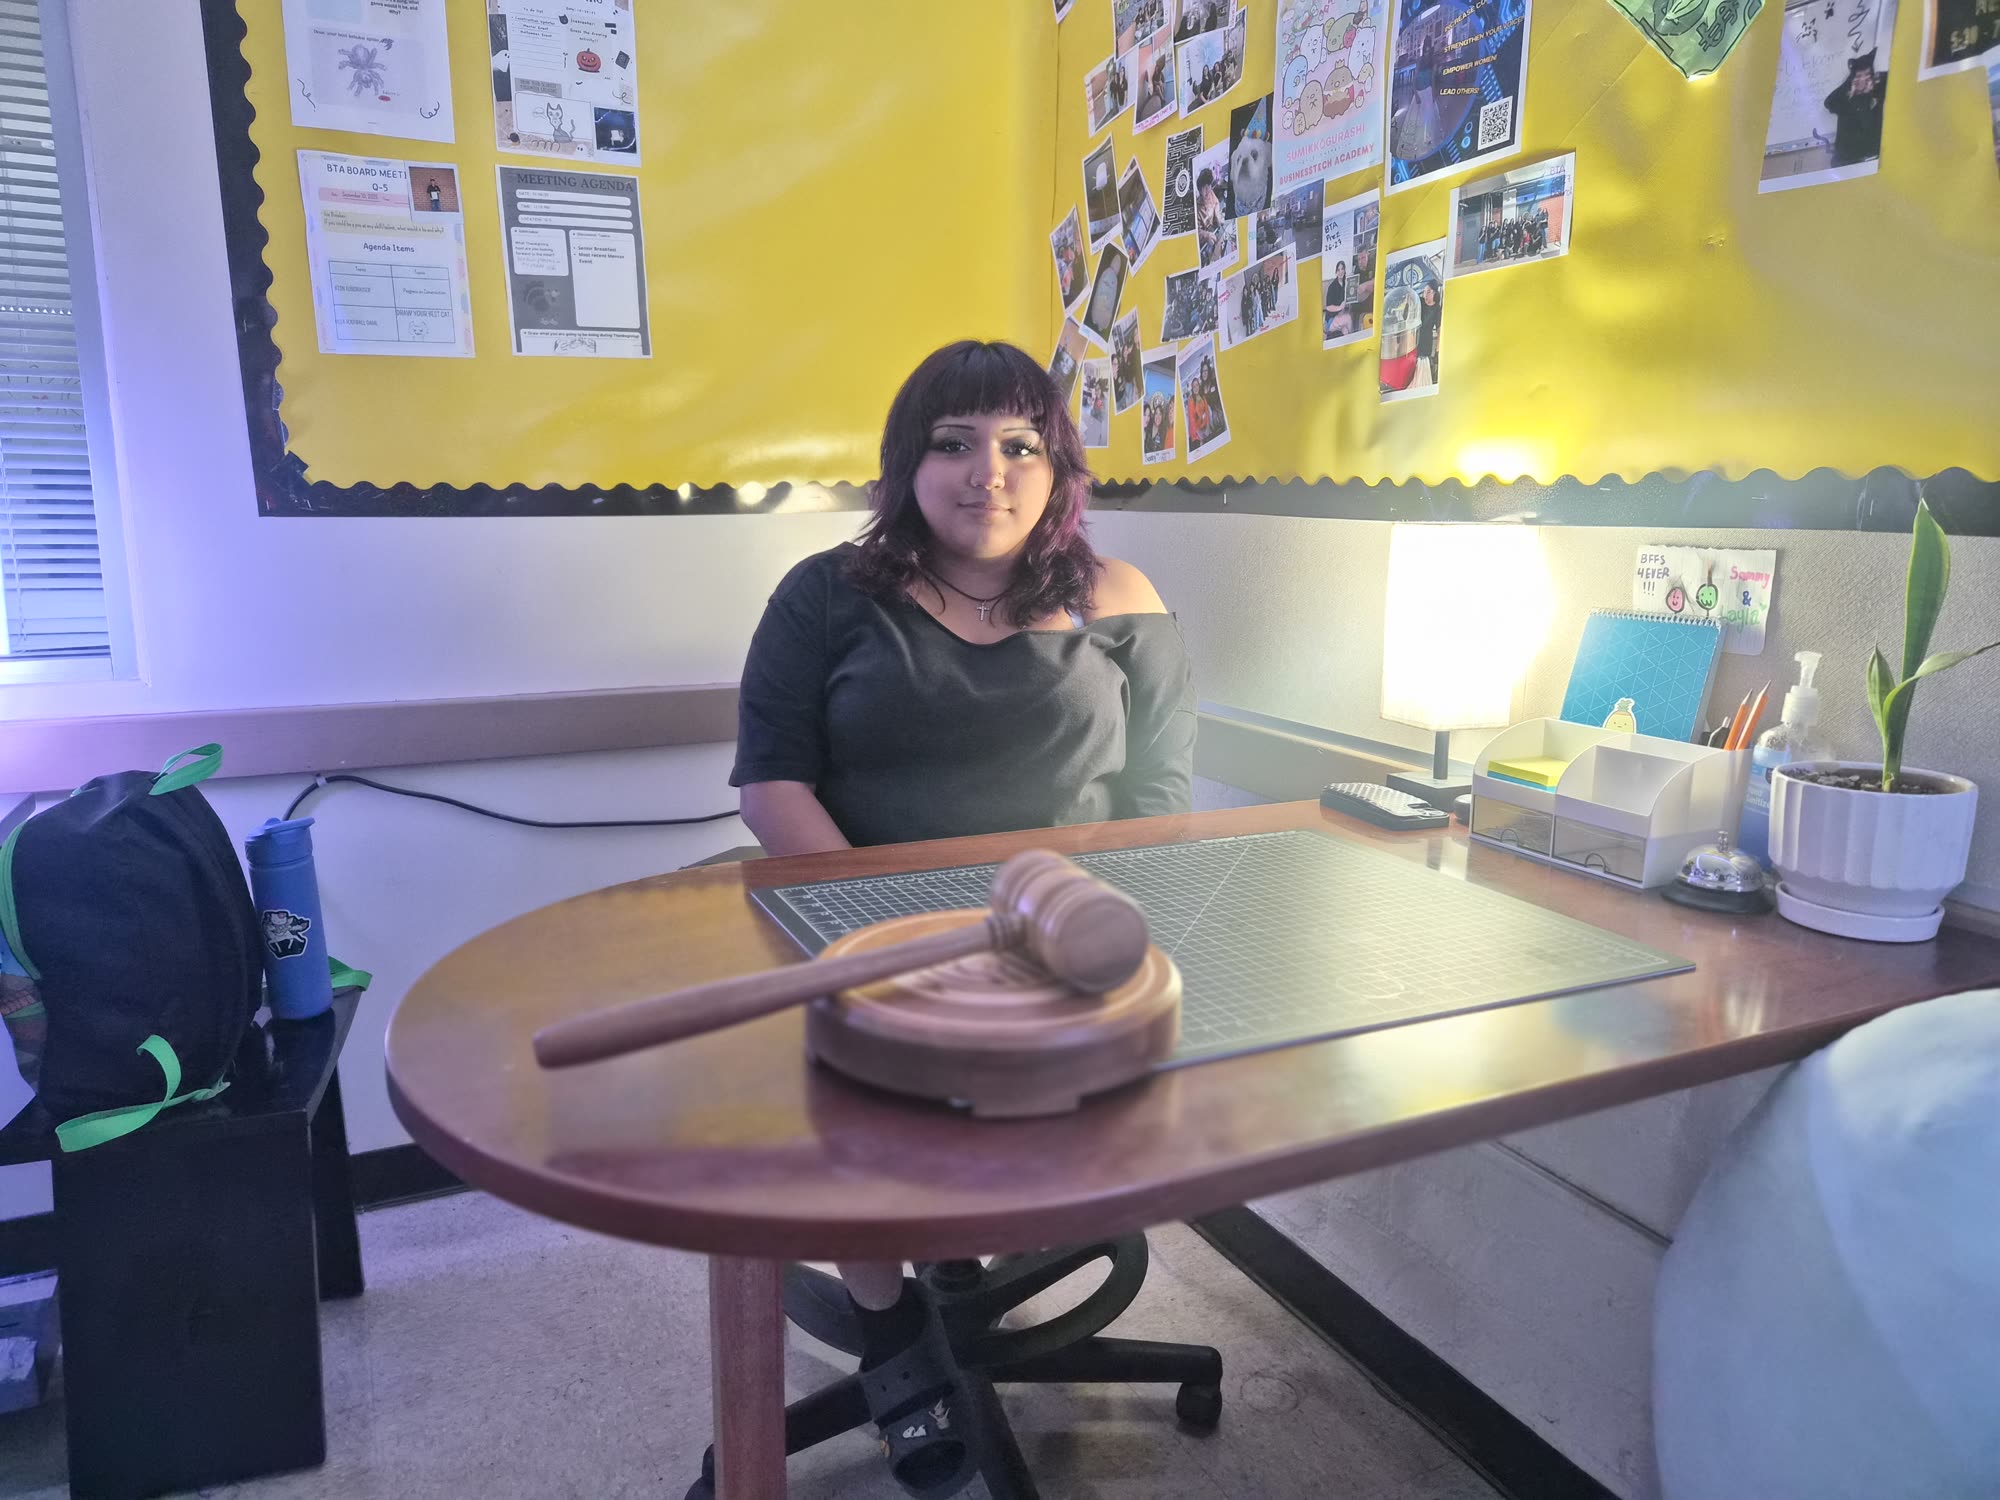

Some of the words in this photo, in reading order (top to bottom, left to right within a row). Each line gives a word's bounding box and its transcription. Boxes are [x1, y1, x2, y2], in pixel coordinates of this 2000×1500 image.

[1444, 5, 1475, 32] INCREASE
[1444, 32, 1485, 53] STRENGTHEN
[1485, 25, 1502, 37] YOUR
[1442, 61, 1473, 75] EMPOWER
[1286, 123, 1365, 161] SUMIKKOGURASHI
[326, 163, 345, 174] BTA
[347, 166, 377, 176] BOARD
[1280, 159, 1332, 186] BUSINESSTECH
[1334, 143, 1375, 166] ACADEMY
[1551, 164, 1565, 175] BTA
[372, 183, 389, 192] Q-5
[516, 173, 577, 187] MEETING
[580, 178, 634, 192] AGENDA
[1325, 221, 1339, 234] BTA
[363, 242, 391, 251] Agenda
[392, 244, 415, 252] Items
[1640, 553, 1666, 565] BFFS
[1637, 566, 1670, 580] 4EVER
[1729, 565, 1771, 589] Sammy
[1643, 581, 1655, 596] !!!
[1741, 590, 1752, 607] &
[1718, 606, 1761, 634] Layla
